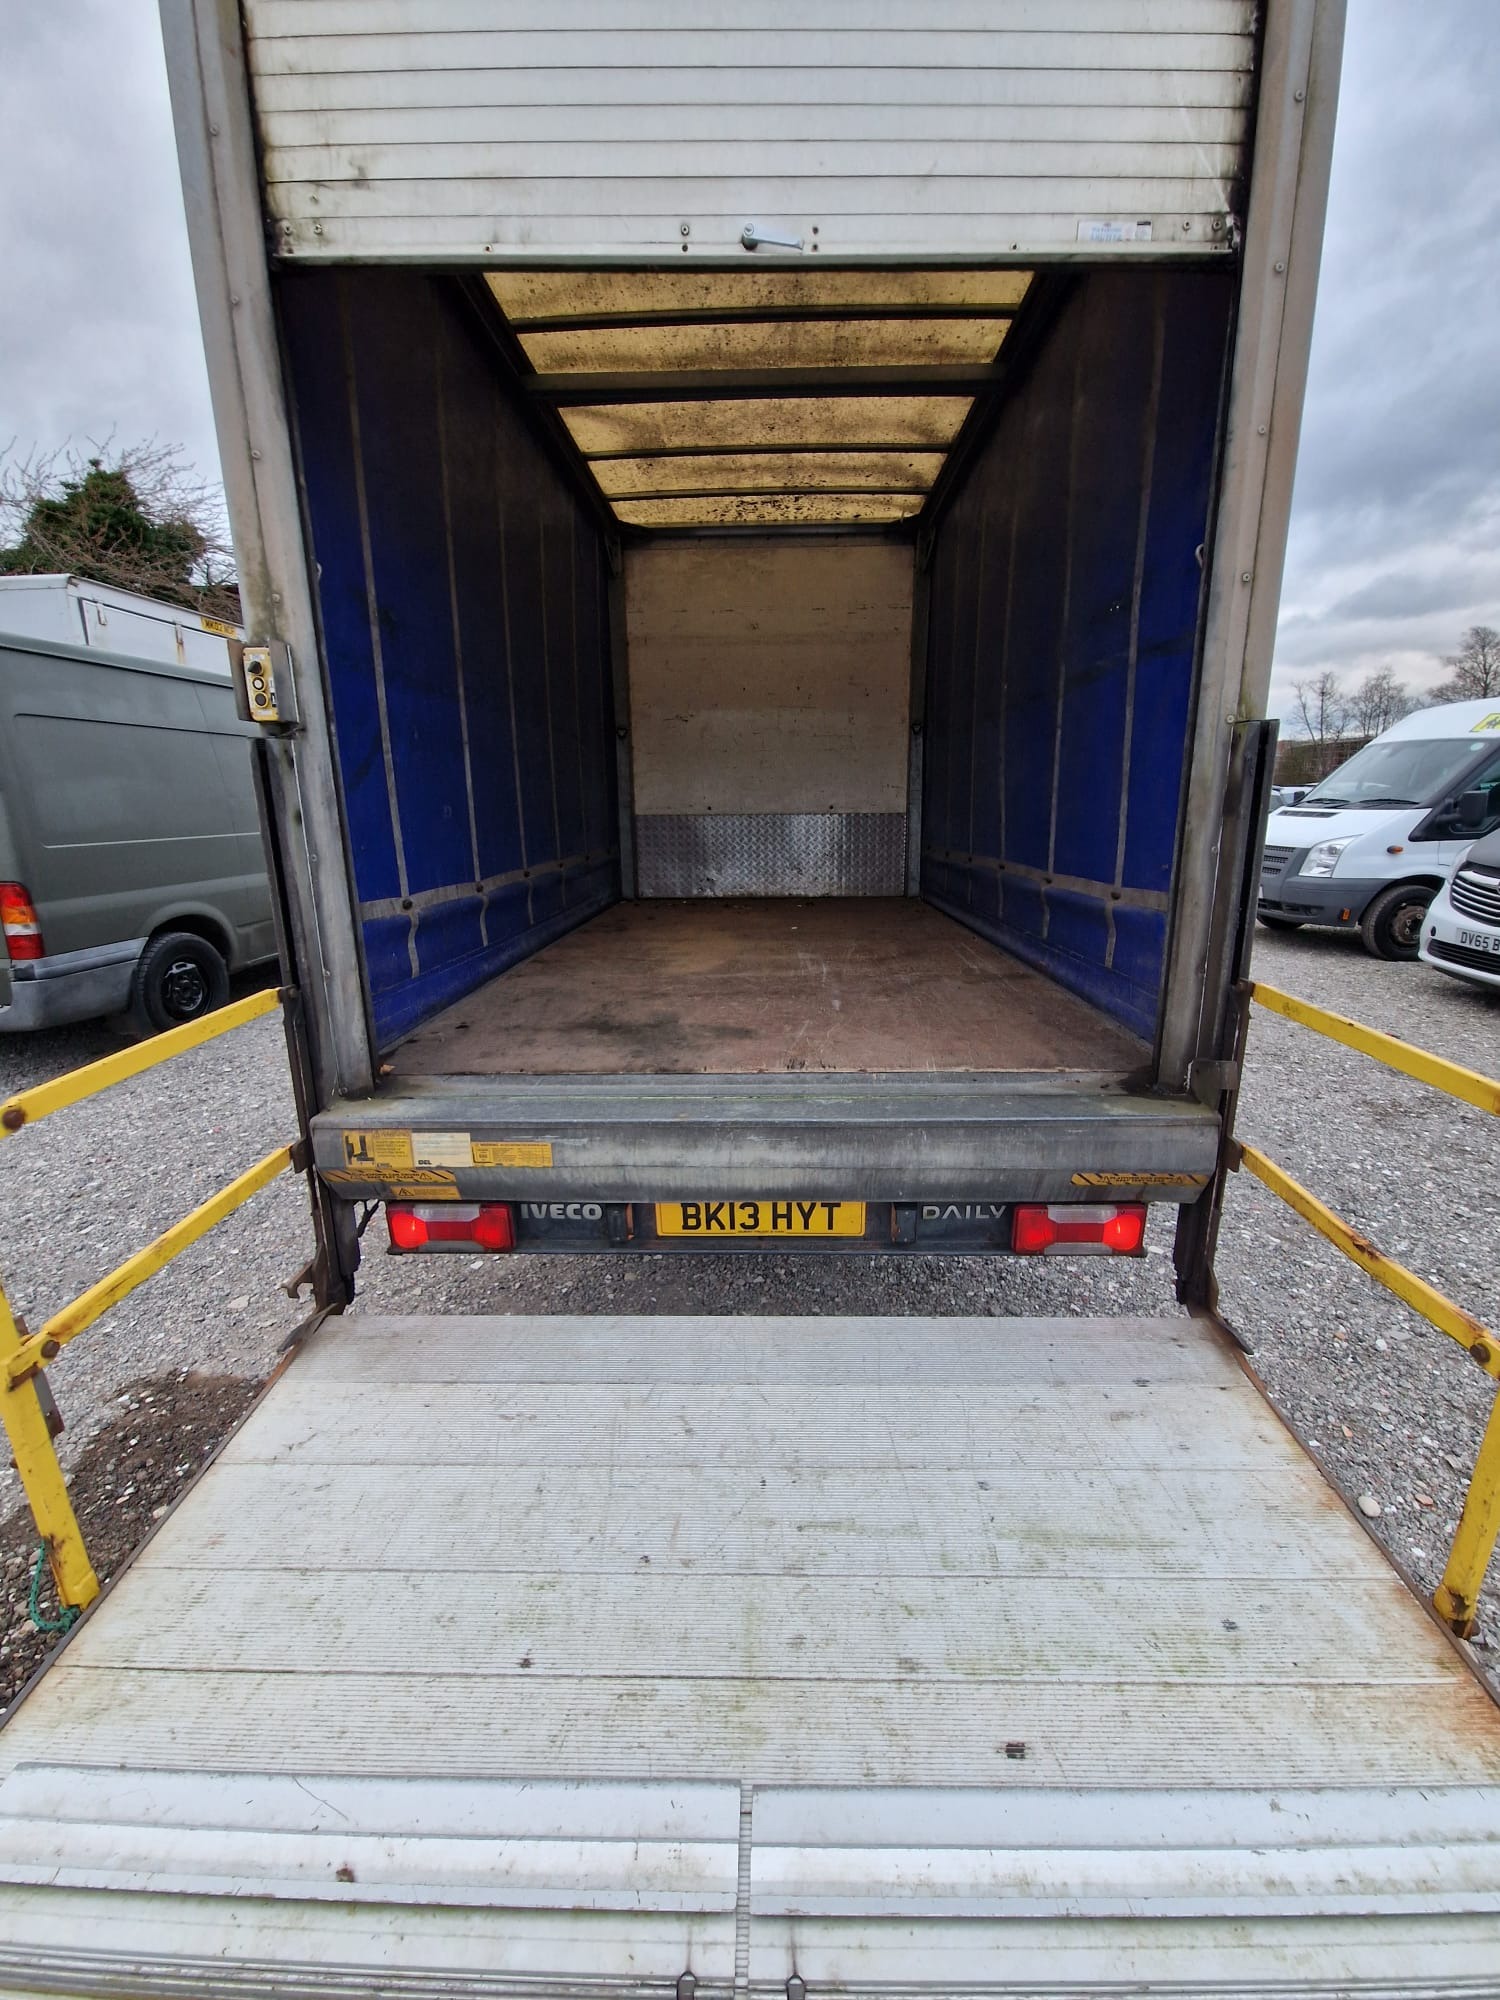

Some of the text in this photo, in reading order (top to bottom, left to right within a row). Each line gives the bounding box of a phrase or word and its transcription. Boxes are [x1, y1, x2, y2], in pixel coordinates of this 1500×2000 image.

[1460, 931, 1490, 948] DV65
[521, 1203, 603, 1220] IVECO
[681, 1202, 841, 1230] BK13 HYT
[922, 1205, 1006, 1219] DAILY
